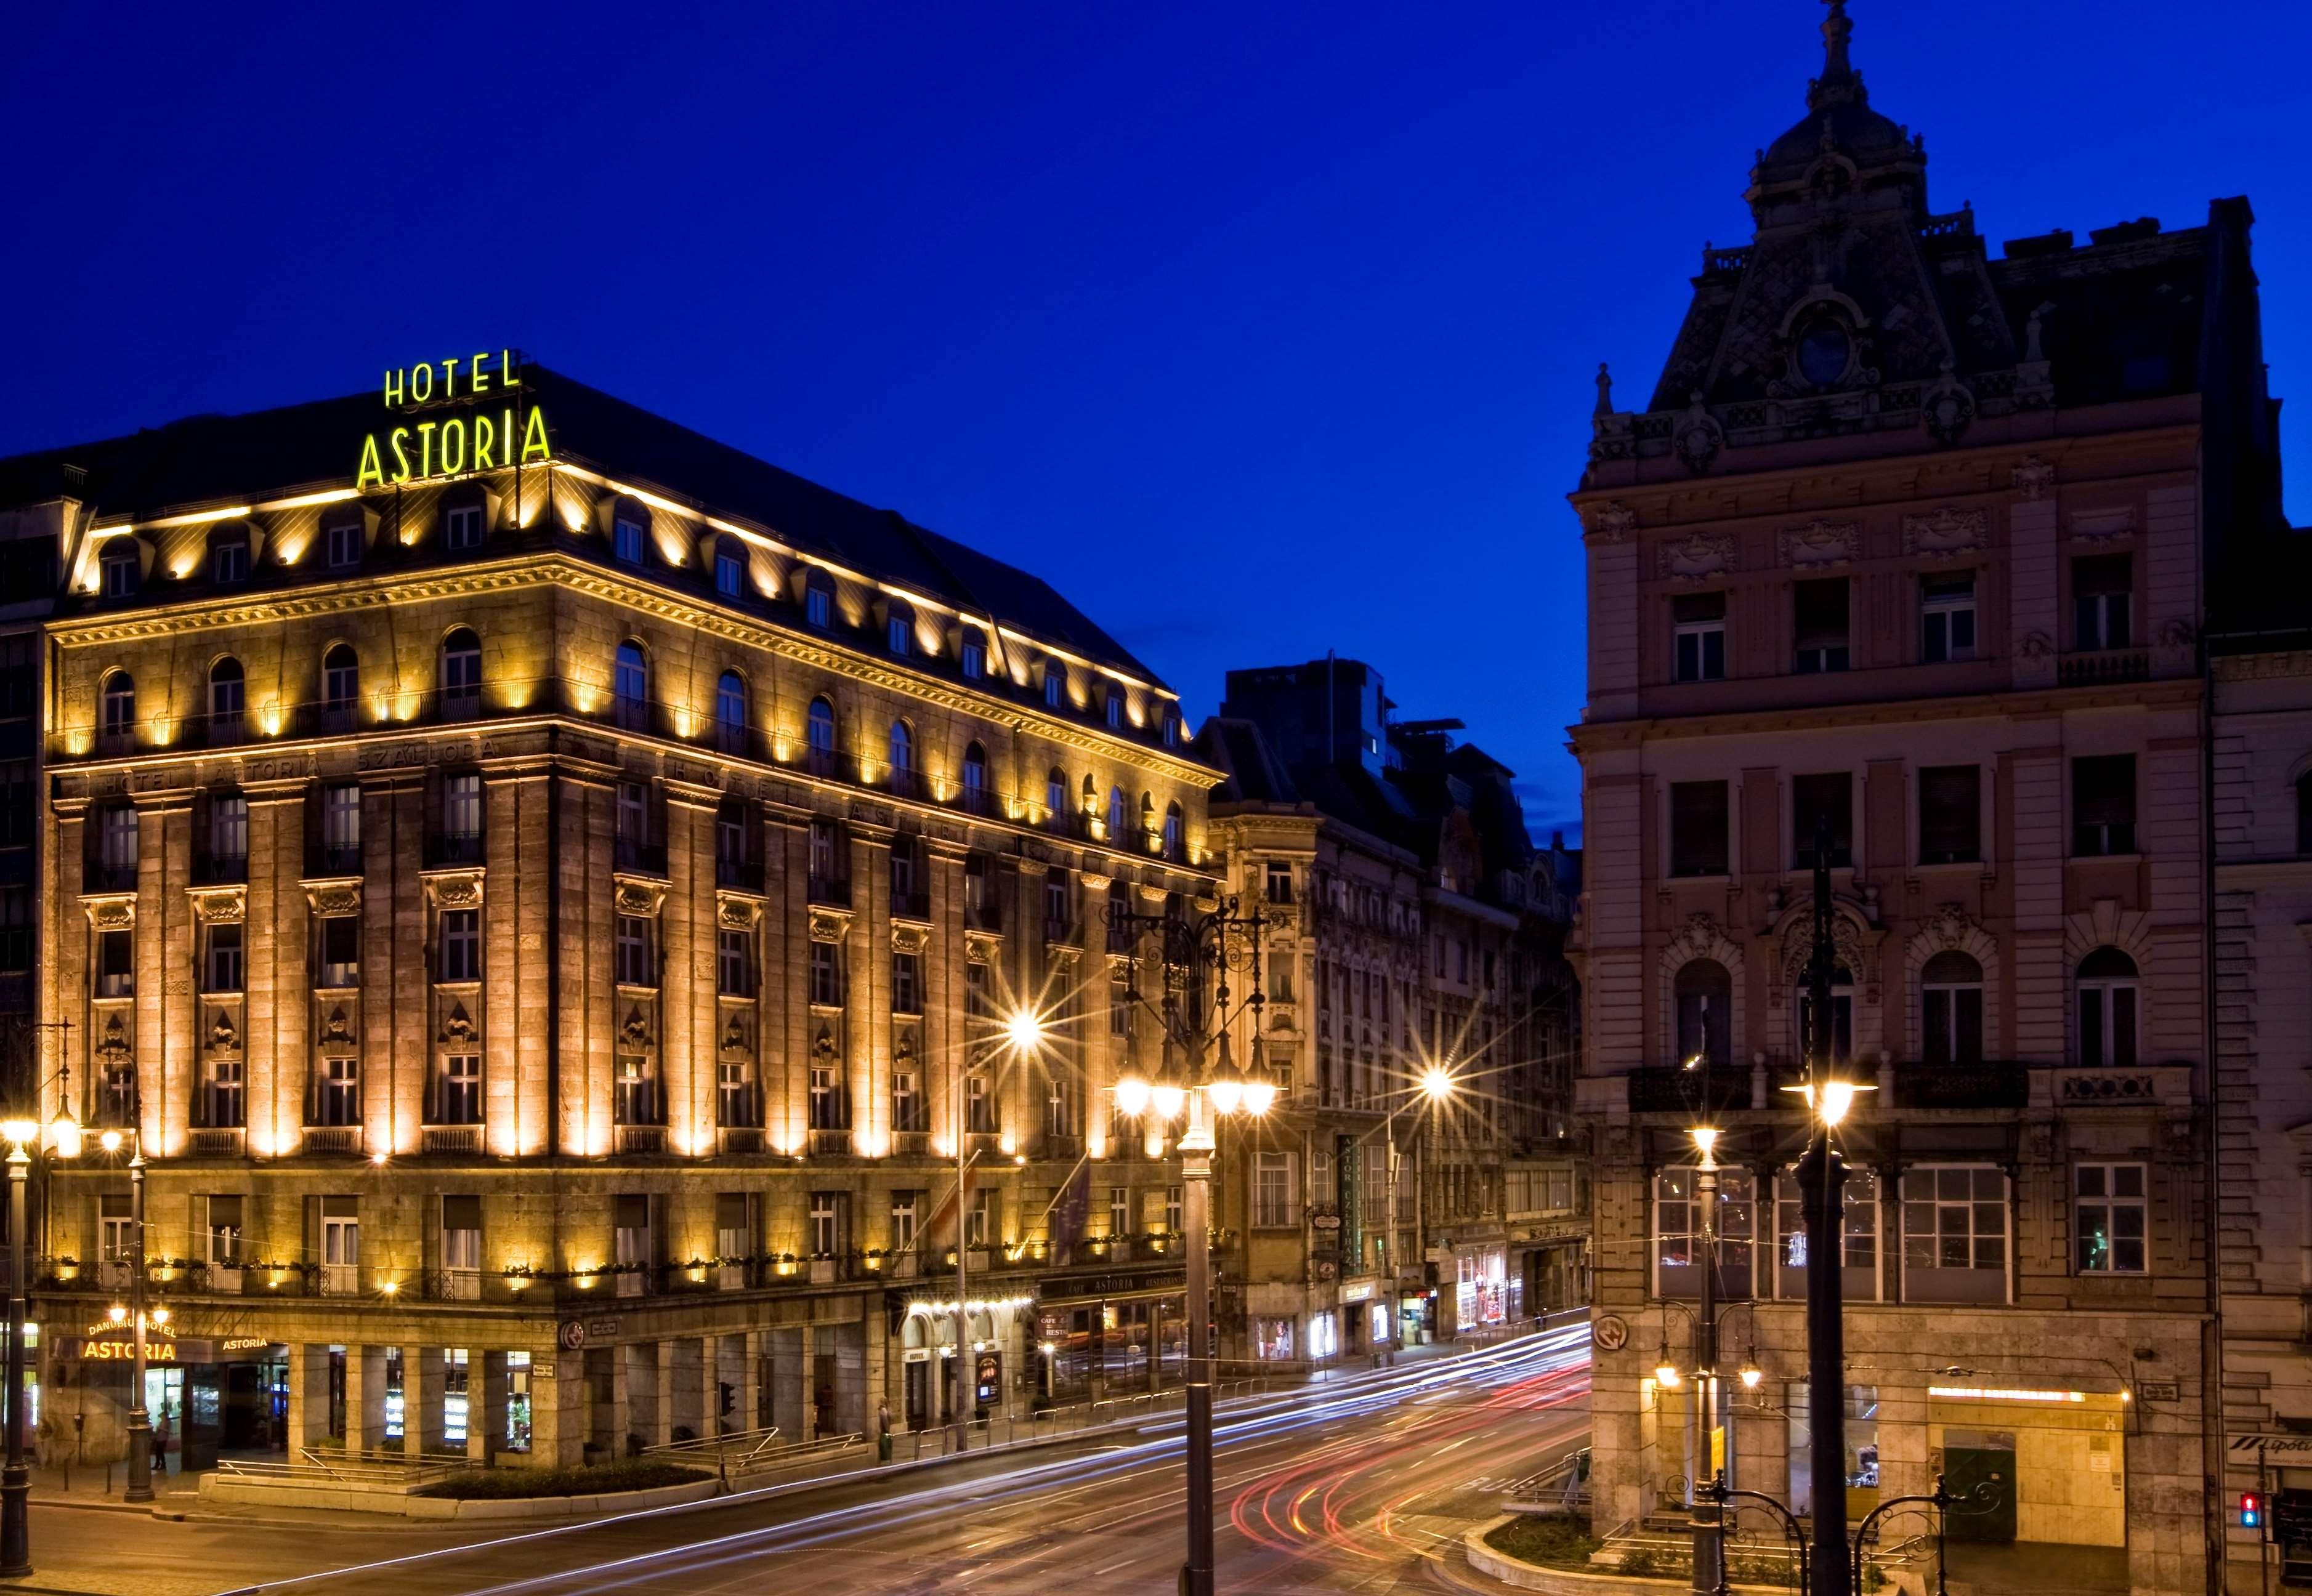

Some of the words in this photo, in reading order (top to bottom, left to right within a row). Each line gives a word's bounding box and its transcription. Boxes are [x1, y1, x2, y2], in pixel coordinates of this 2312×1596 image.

[384, 349, 522, 408] HOTEL
[357, 405, 551, 490] ASTORIA
[105, 771, 178, 794] HOTEL
[214, 757, 321, 784] ASTORIA
[1094, 1278, 1133, 1292] ASTORIA
[89, 1318, 134, 1336] DANUBIU
[144, 1321, 177, 1338] HOTEL
[84, 1341, 176, 1361] ASTORIA
[222, 1337, 268, 1350] ASTORIA
